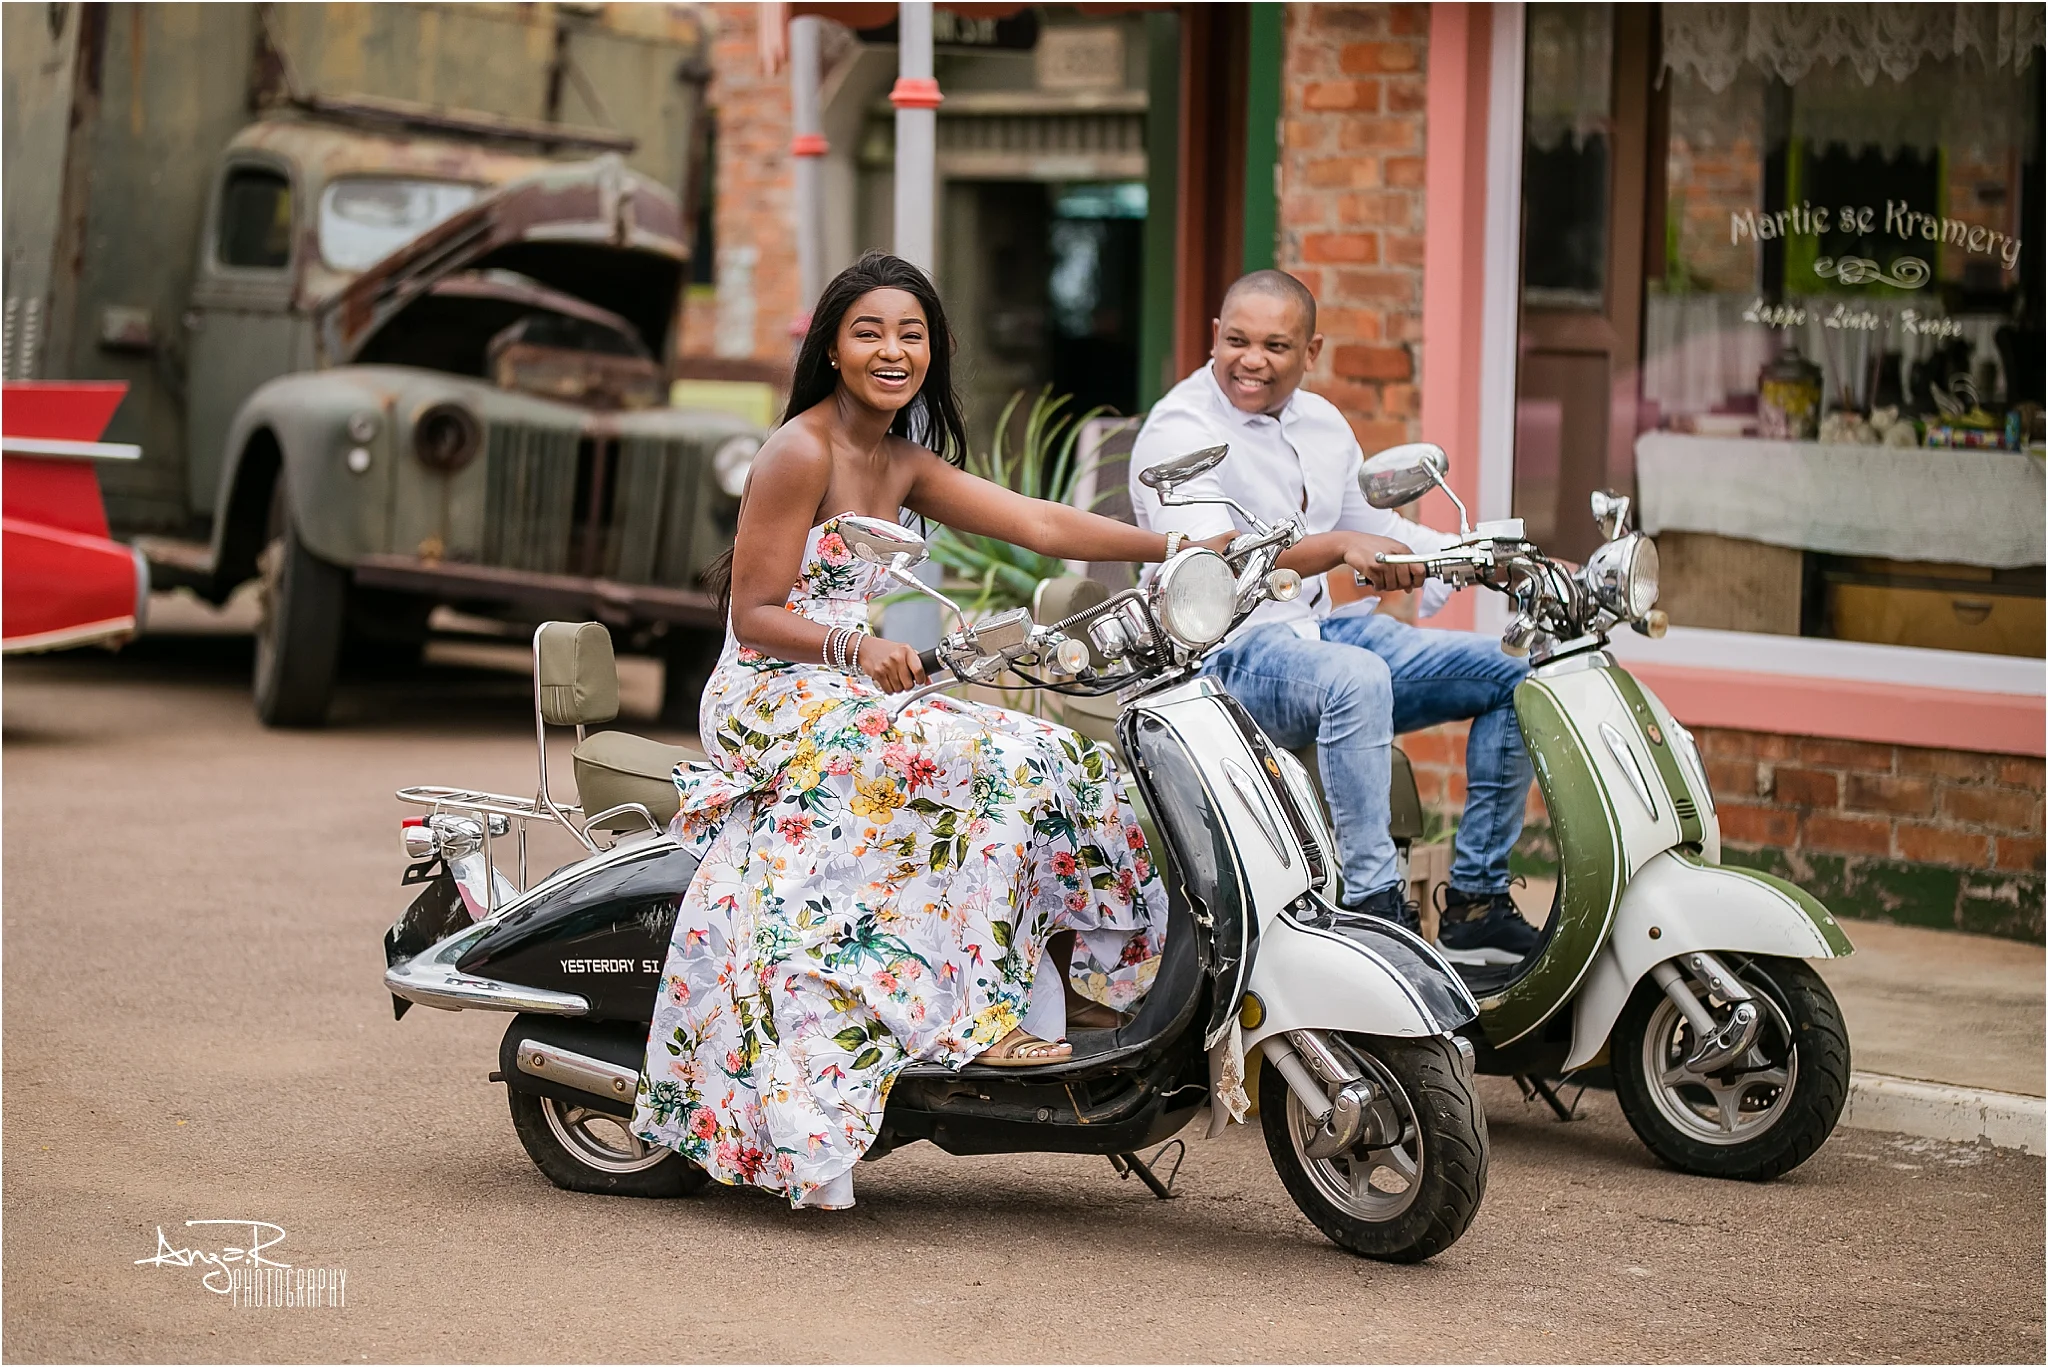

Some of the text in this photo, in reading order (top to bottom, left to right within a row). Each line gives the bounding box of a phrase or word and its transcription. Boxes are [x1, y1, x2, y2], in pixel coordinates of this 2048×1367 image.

[1730, 200, 2022, 271] Martie se Kramery
[560, 959, 635, 973] YESTERDAY
